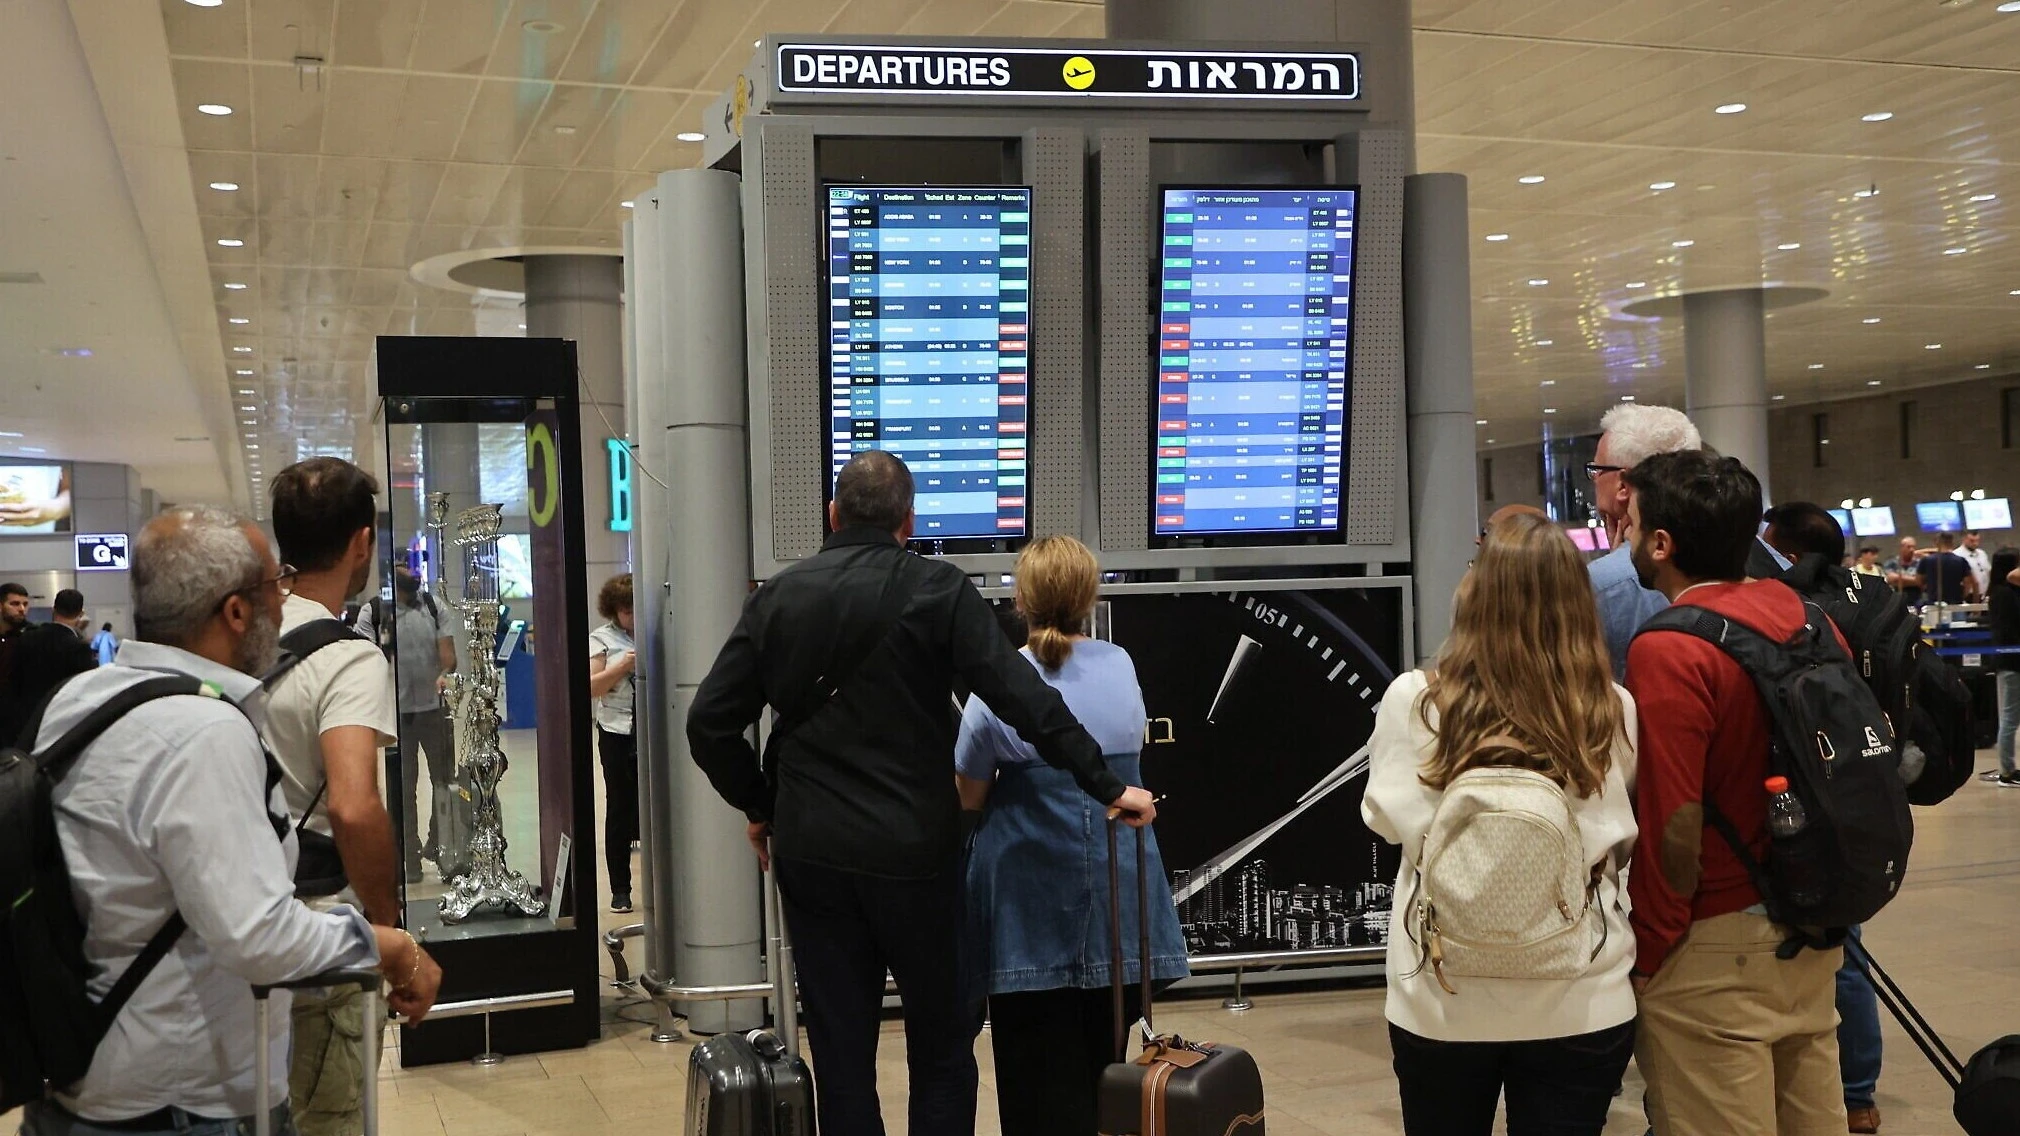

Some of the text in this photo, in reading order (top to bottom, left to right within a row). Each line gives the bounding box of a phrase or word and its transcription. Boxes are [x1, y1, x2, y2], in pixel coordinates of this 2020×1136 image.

[793, 54, 1010, 87] DEPARTURES
[1146, 58, 1340, 92] המראות
[854, 194, 869, 202] Flight
[1254, 603, 1279, 624] 05
